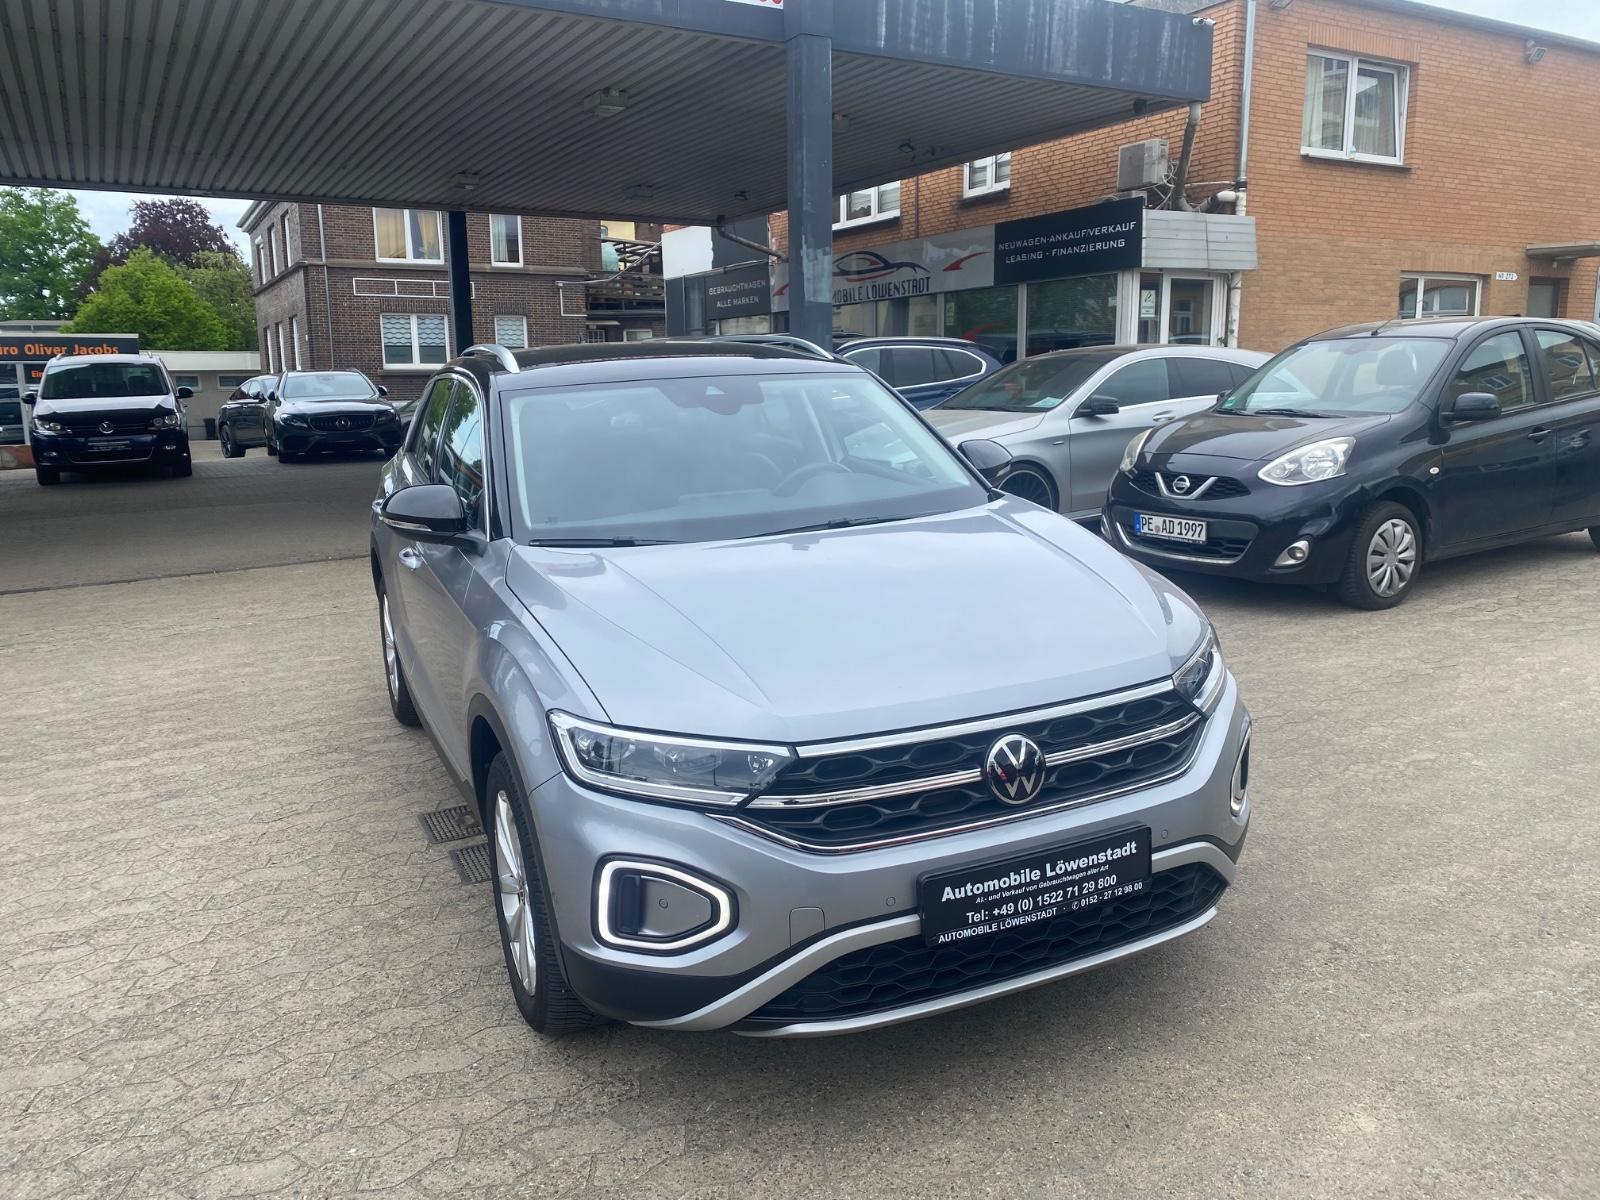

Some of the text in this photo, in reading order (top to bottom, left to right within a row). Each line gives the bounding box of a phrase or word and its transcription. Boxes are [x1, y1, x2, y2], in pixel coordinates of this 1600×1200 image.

[999, 221, 1136, 250] NEUWAGEN-ANKAUF/VERKAUF
[1006, 251, 1043, 264] LEASING
[1052, 238, 1125, 257] FINANZIERUNG
[709, 280, 766, 295] GEBRAUCHTWAGEN
[866, 277, 931, 299] LÖWENSTADT
[717, 296, 759, 308] ALLE MARKEN
[24, 344, 67, 355] Oliver
[73, 343, 119, 355] Jacobs
[1141, 516, 1204, 538] PE AD 1997
[941, 841, 1137, 902] Automobile Löwenstadt
[988, 892, 1001, 901] und
[1002, 886, 1025, 898] Verkauf
[1025, 884, 1038, 892] von
[1100, 864, 1109, 872] Art
[939, 923, 998, 943] AUTOMOBILE
[1000, 907, 1057, 930] LÖWENSTADT
[1081, 895, 1098, 907] 0152
[1103, 890, 1112, 900] 27
[1114, 887, 1123, 896] 12
[1134, 881, 1143, 891] 00
[966, 874, 1117, 924] Tel: +49 (0) 1522 71 29 800
